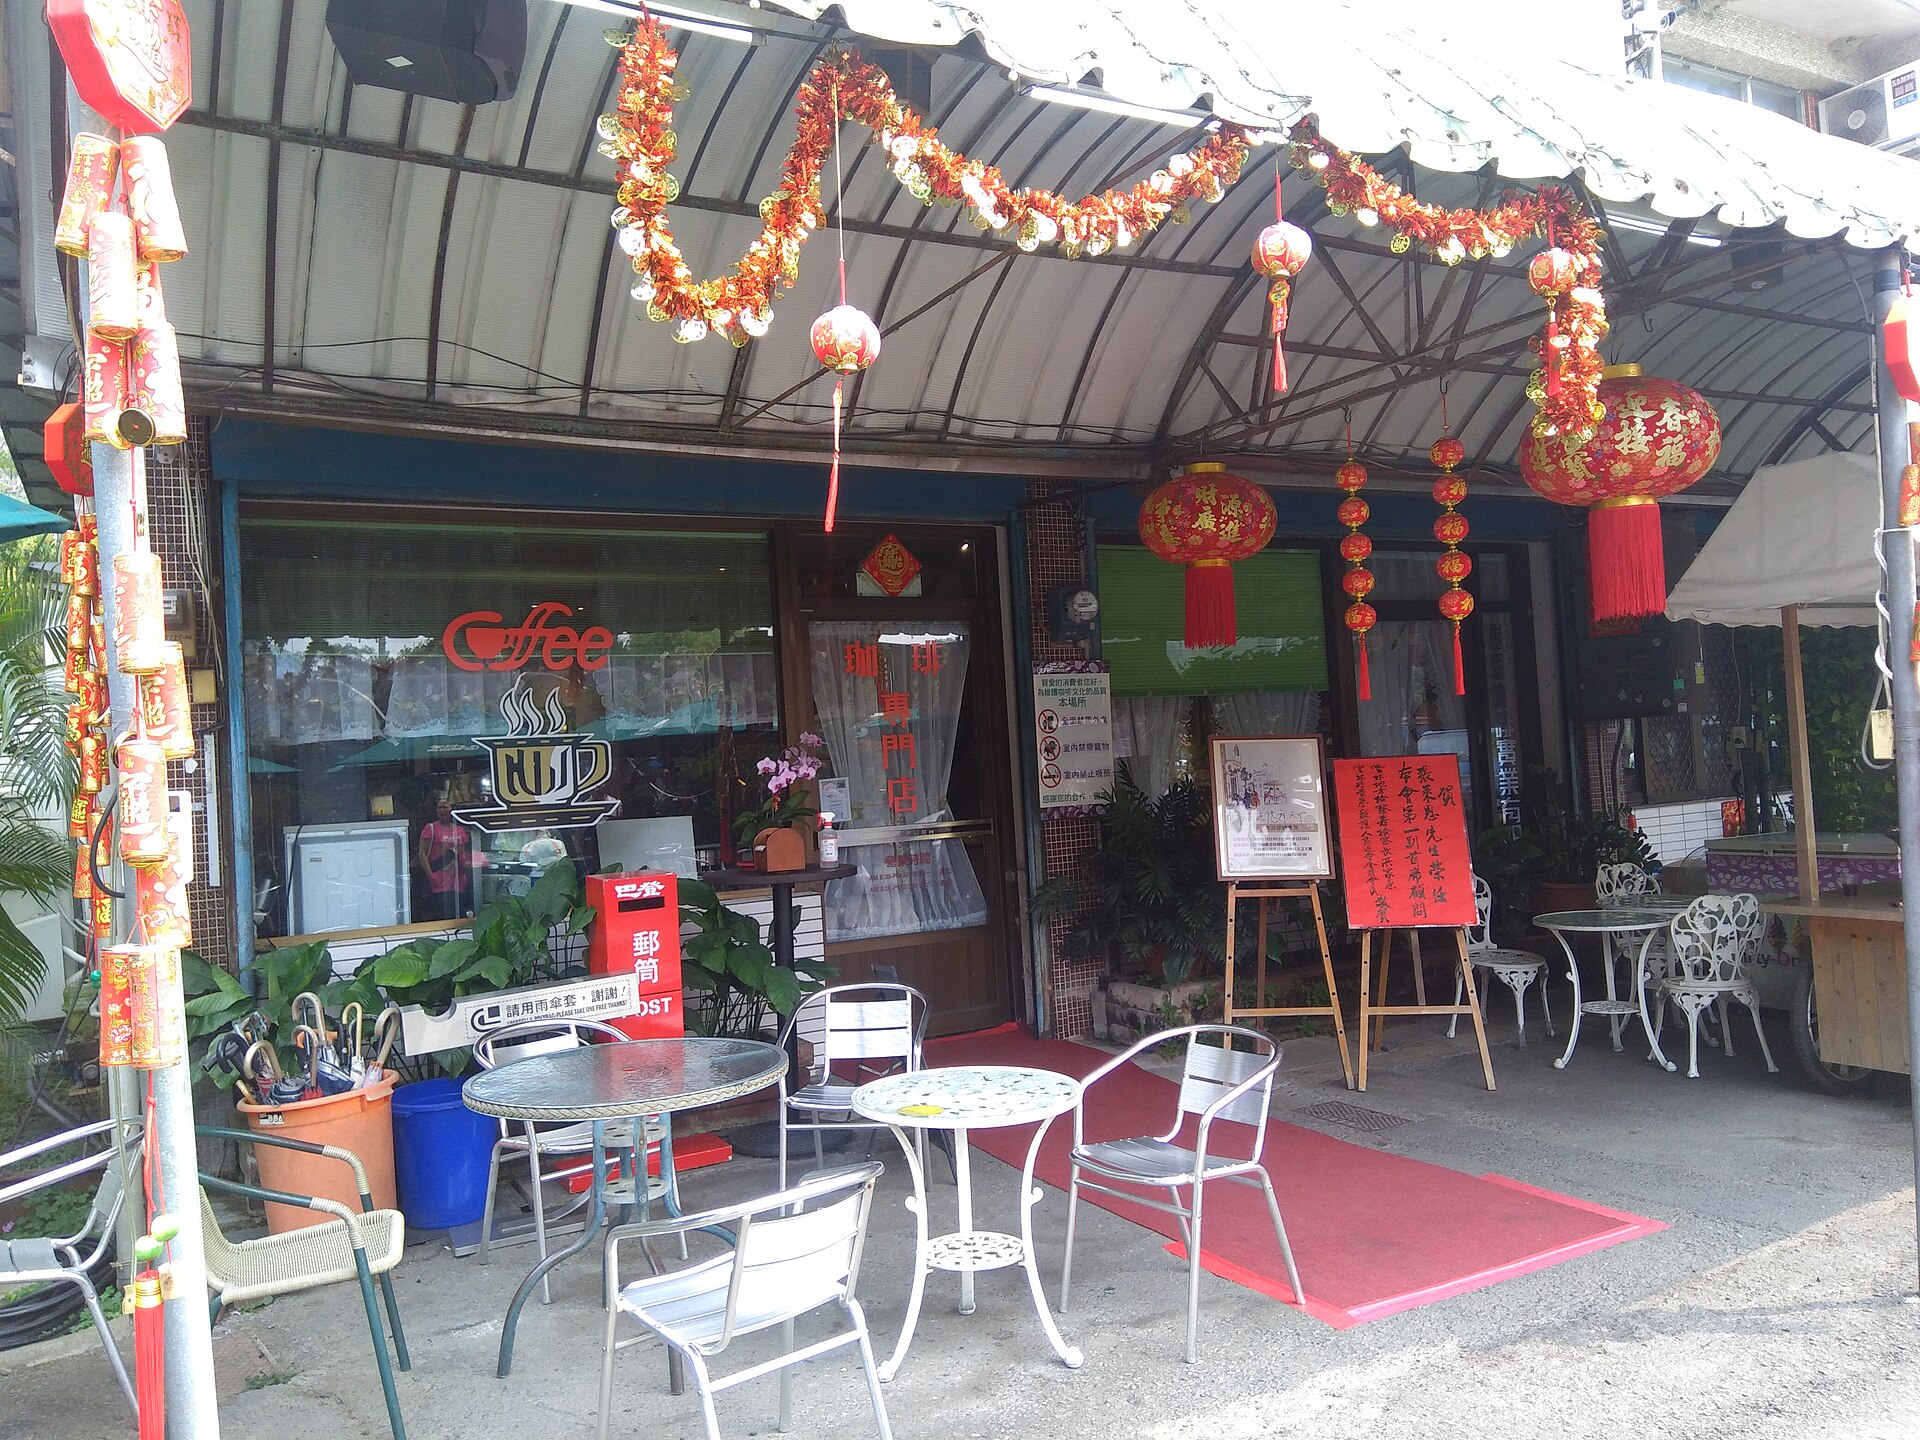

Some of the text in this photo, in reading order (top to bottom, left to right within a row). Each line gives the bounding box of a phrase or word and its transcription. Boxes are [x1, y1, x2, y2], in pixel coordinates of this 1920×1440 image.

[1442, 519, 1465, 537] 福
[1441, 555, 1465, 574] 福
[1058, 697, 1087, 708] 本場所
[880, 691, 918, 815] 專門店
[1438, 785, 1456, 806] 賀
[614, 881, 665, 898] 巴登
[632, 930, 660, 984] 郵筒
[574, 1006, 585, 1015] TAKE
[596, 1002, 607, 1011] FREE
[621, 997, 673, 1018] OST
